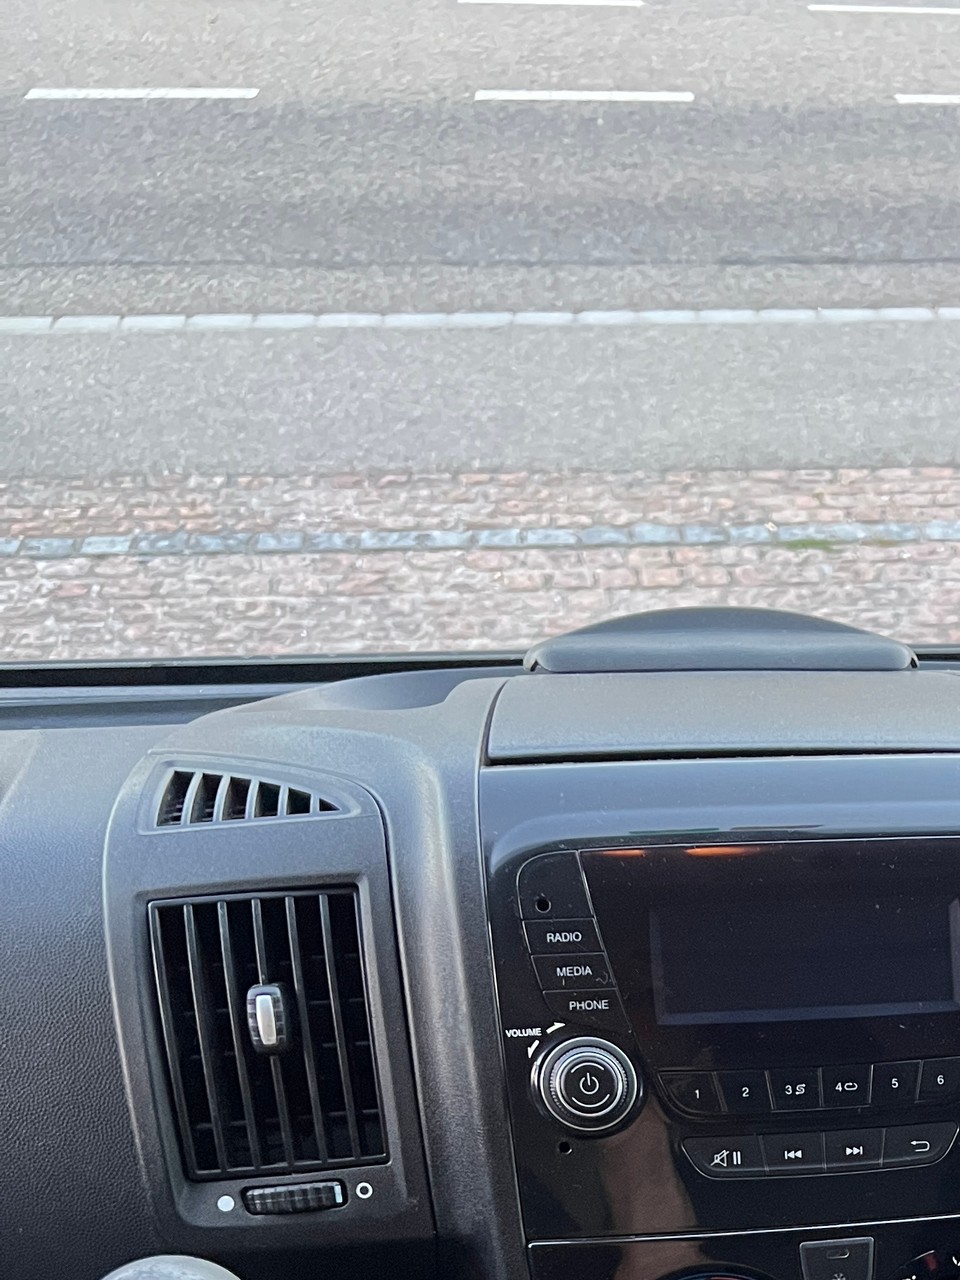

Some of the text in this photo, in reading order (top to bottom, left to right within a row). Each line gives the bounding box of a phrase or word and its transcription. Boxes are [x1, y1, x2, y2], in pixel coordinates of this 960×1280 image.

[546, 931, 582, 943] RADIO
[556, 965, 593, 977] MEDIA
[569, 999, 610, 1011] PHONE
[505, 1027, 542, 1038] VOLUME
[891, 1078, 899, 1089] 5
[936, 1074, 945, 1085] 6
[741, 1087, 750, 1098] 2
[784, 1085, 793, 1095] 3
[835, 1082, 843, 1093] 4
[694, 1088, 701, 1100] 1
